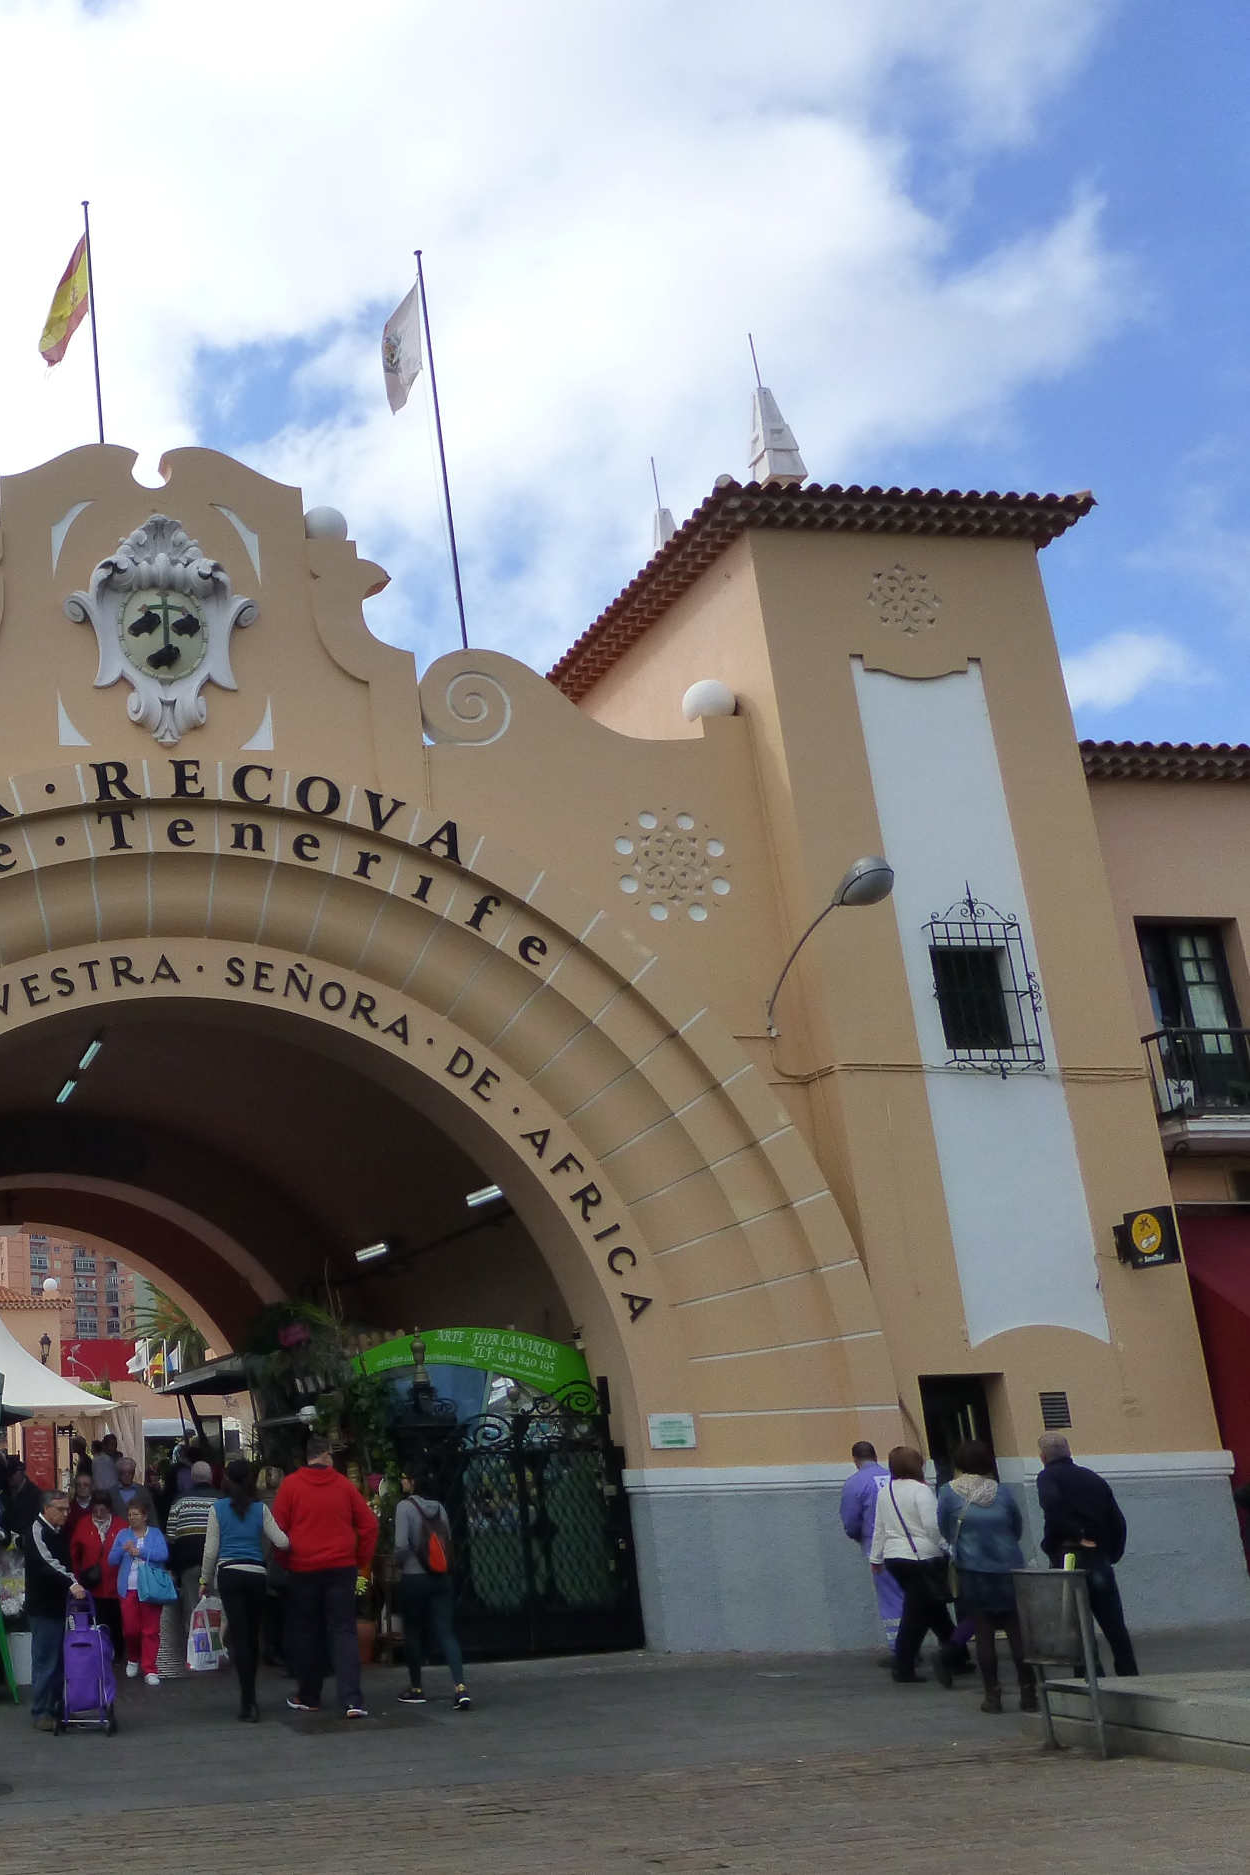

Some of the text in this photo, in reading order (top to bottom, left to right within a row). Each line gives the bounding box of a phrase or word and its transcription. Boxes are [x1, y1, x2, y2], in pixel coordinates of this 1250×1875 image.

[89, 759, 462, 865] RECOVA
[227, 957, 410, 1046] SEÑORA
[446, 1047, 500, 1101] DE
[520, 1129, 653, 1323] AFRICA
[501, 1335, 558, 1359] CANARIAS
